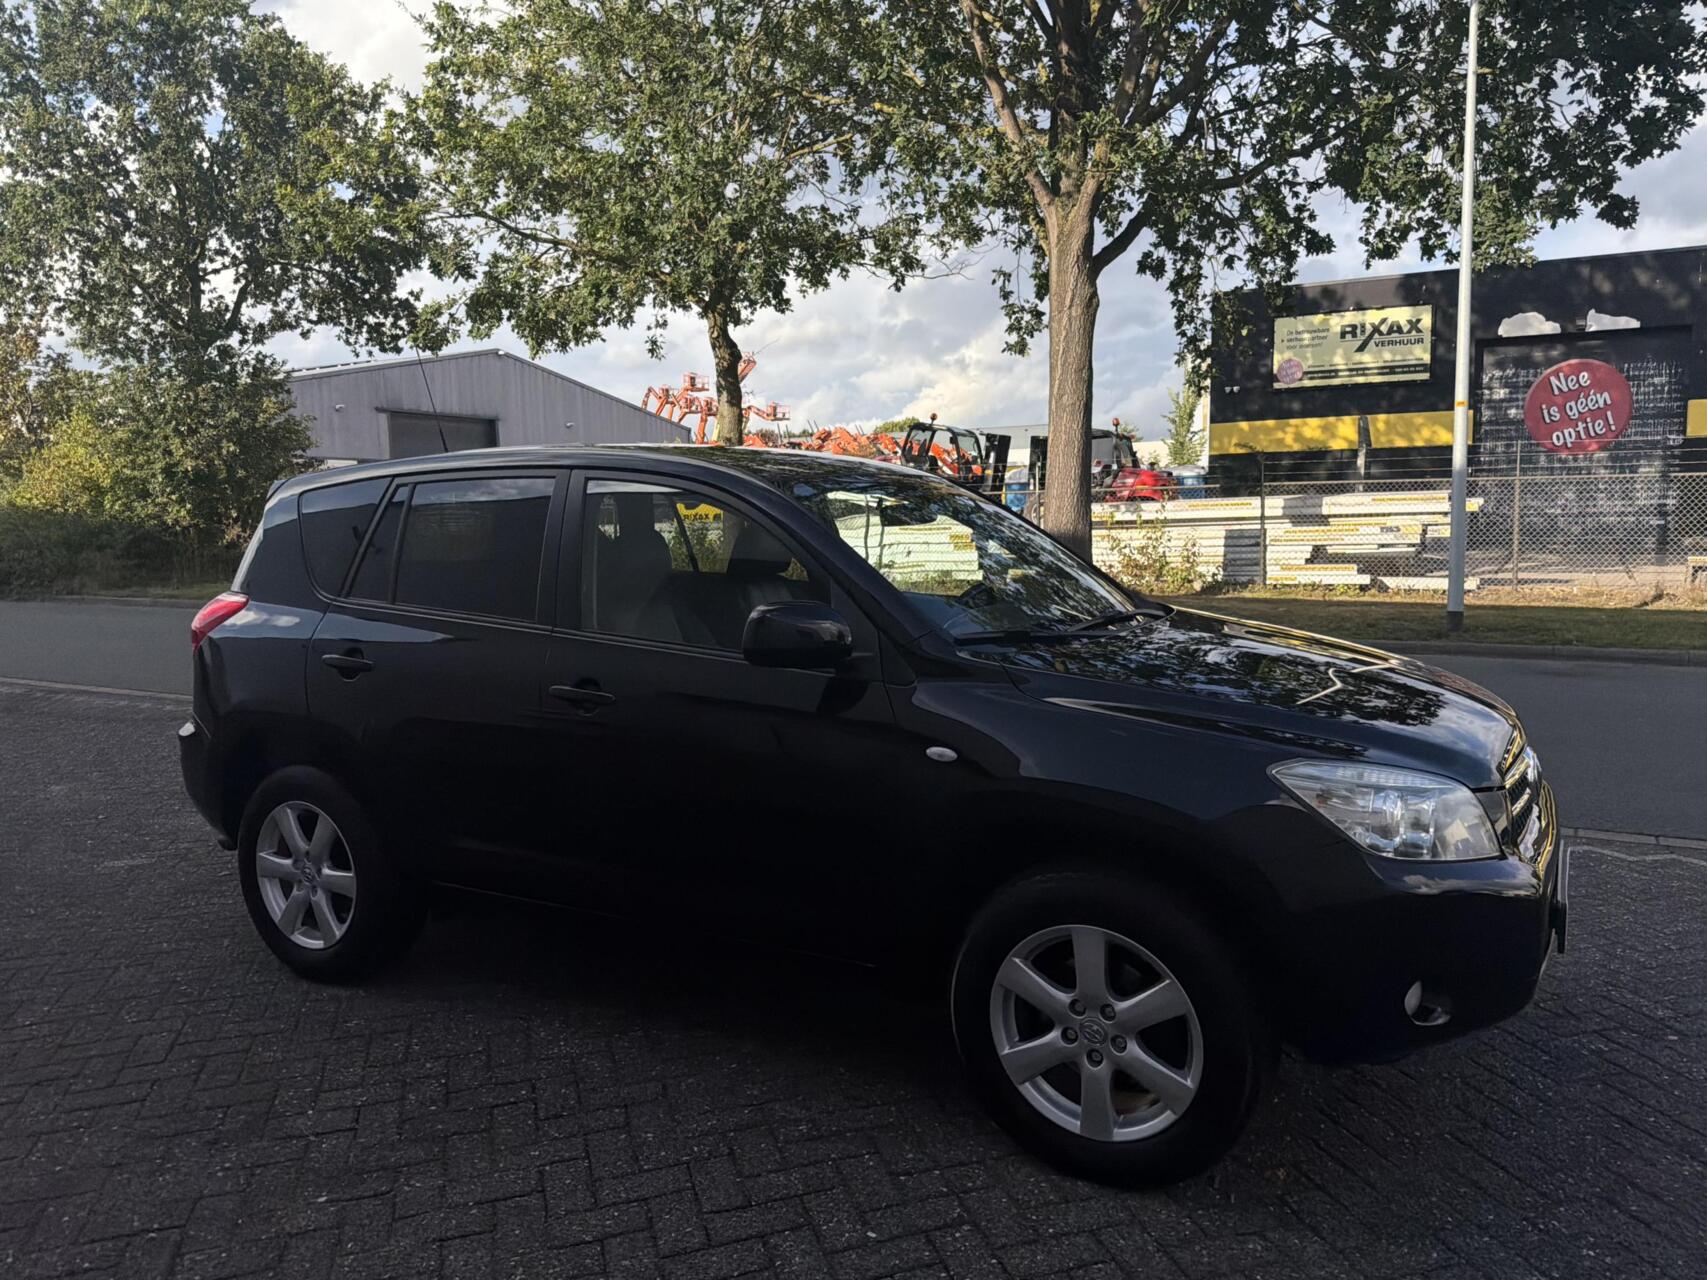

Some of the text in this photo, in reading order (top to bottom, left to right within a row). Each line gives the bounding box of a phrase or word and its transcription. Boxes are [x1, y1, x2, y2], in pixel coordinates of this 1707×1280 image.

[1340, 317, 1423, 352] RIXAX
[1374, 337, 1424, 348] VERHUUR
[1550, 371, 1590, 395] Nee
[1542, 390, 1611, 424] is géén
